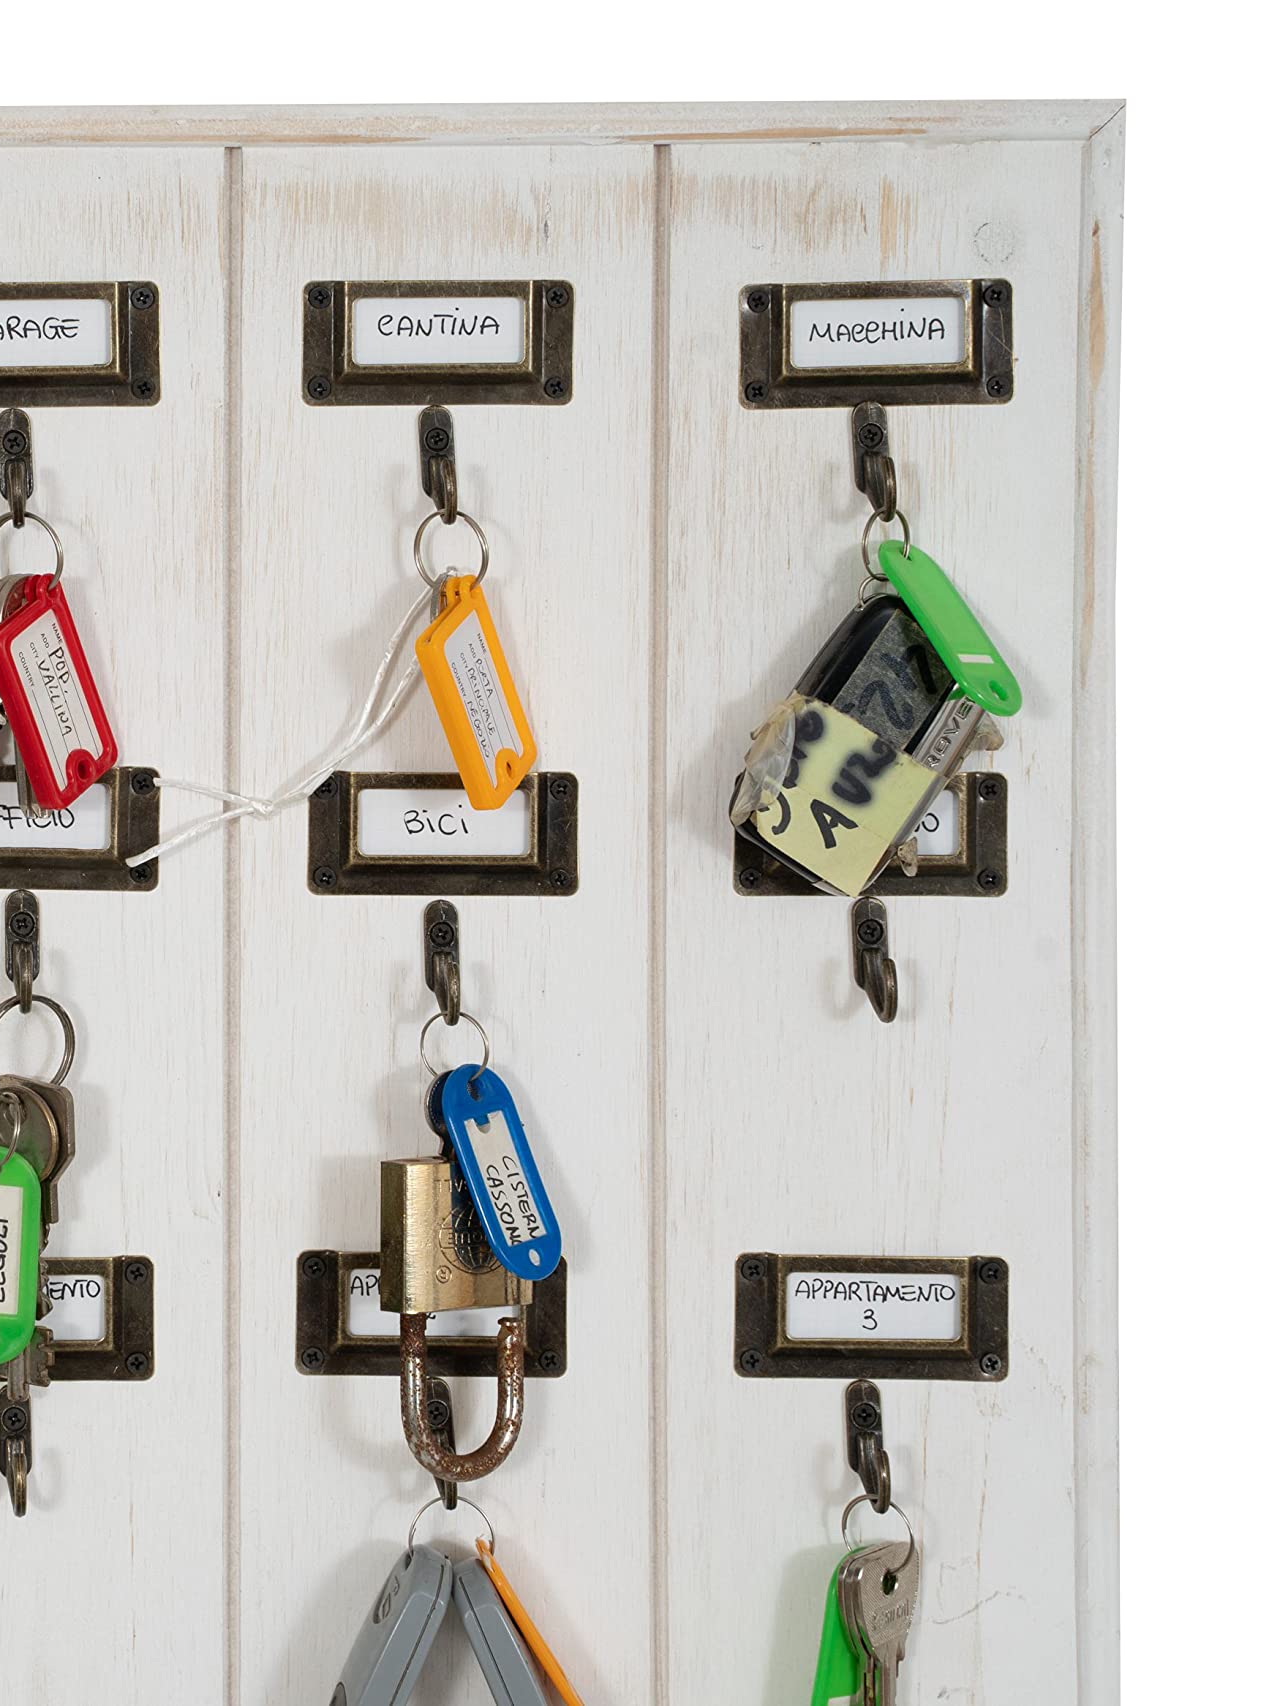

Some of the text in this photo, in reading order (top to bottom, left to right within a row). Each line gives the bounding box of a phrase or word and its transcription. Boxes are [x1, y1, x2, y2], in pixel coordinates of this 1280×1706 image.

[40, 633, 50, 649] ADD
[52, 623, 63, 644] NAME
[29, 642, 39, 659] CITY
[18, 651, 36, 688] COUNTRY
[926, 694, 976, 769] ROVE
[794, 1278, 957, 1304] APPARTAMENTO
[862, 1308, 878, 1331] 3
